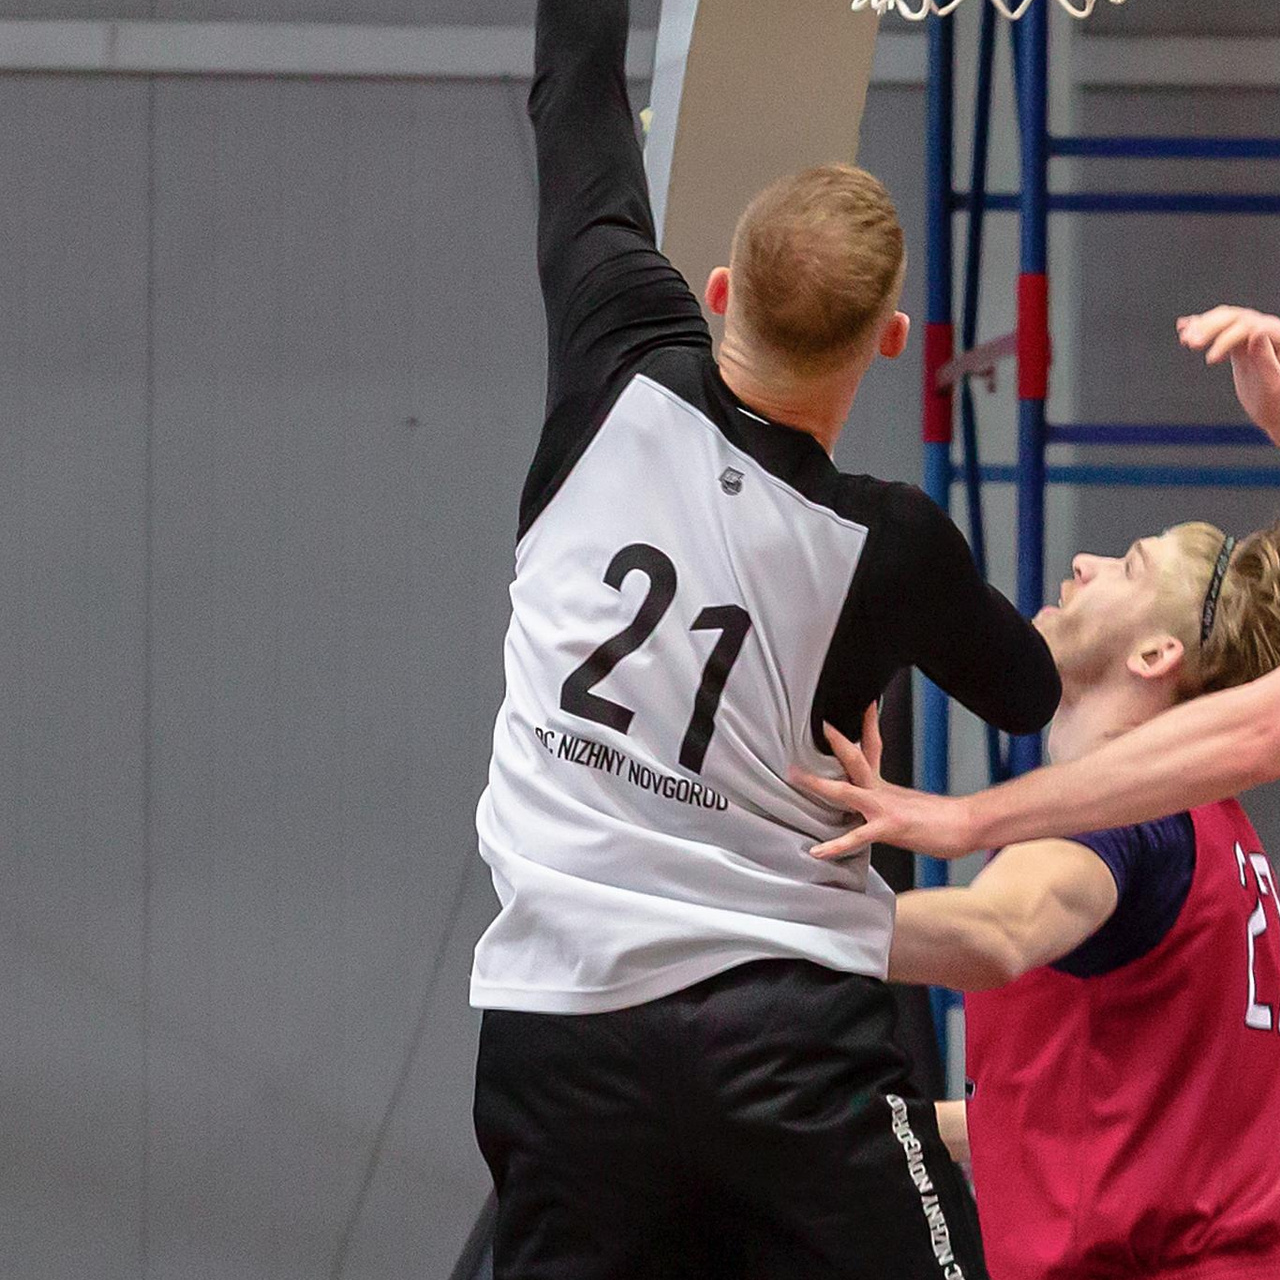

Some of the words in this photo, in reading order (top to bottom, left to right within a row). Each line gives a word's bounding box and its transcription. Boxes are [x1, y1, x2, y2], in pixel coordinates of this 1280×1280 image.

[559, 542, 754, 775] 21
[557, 735, 626, 776] NIZHNY
[628, 759, 729, 812] NOVGOROD
